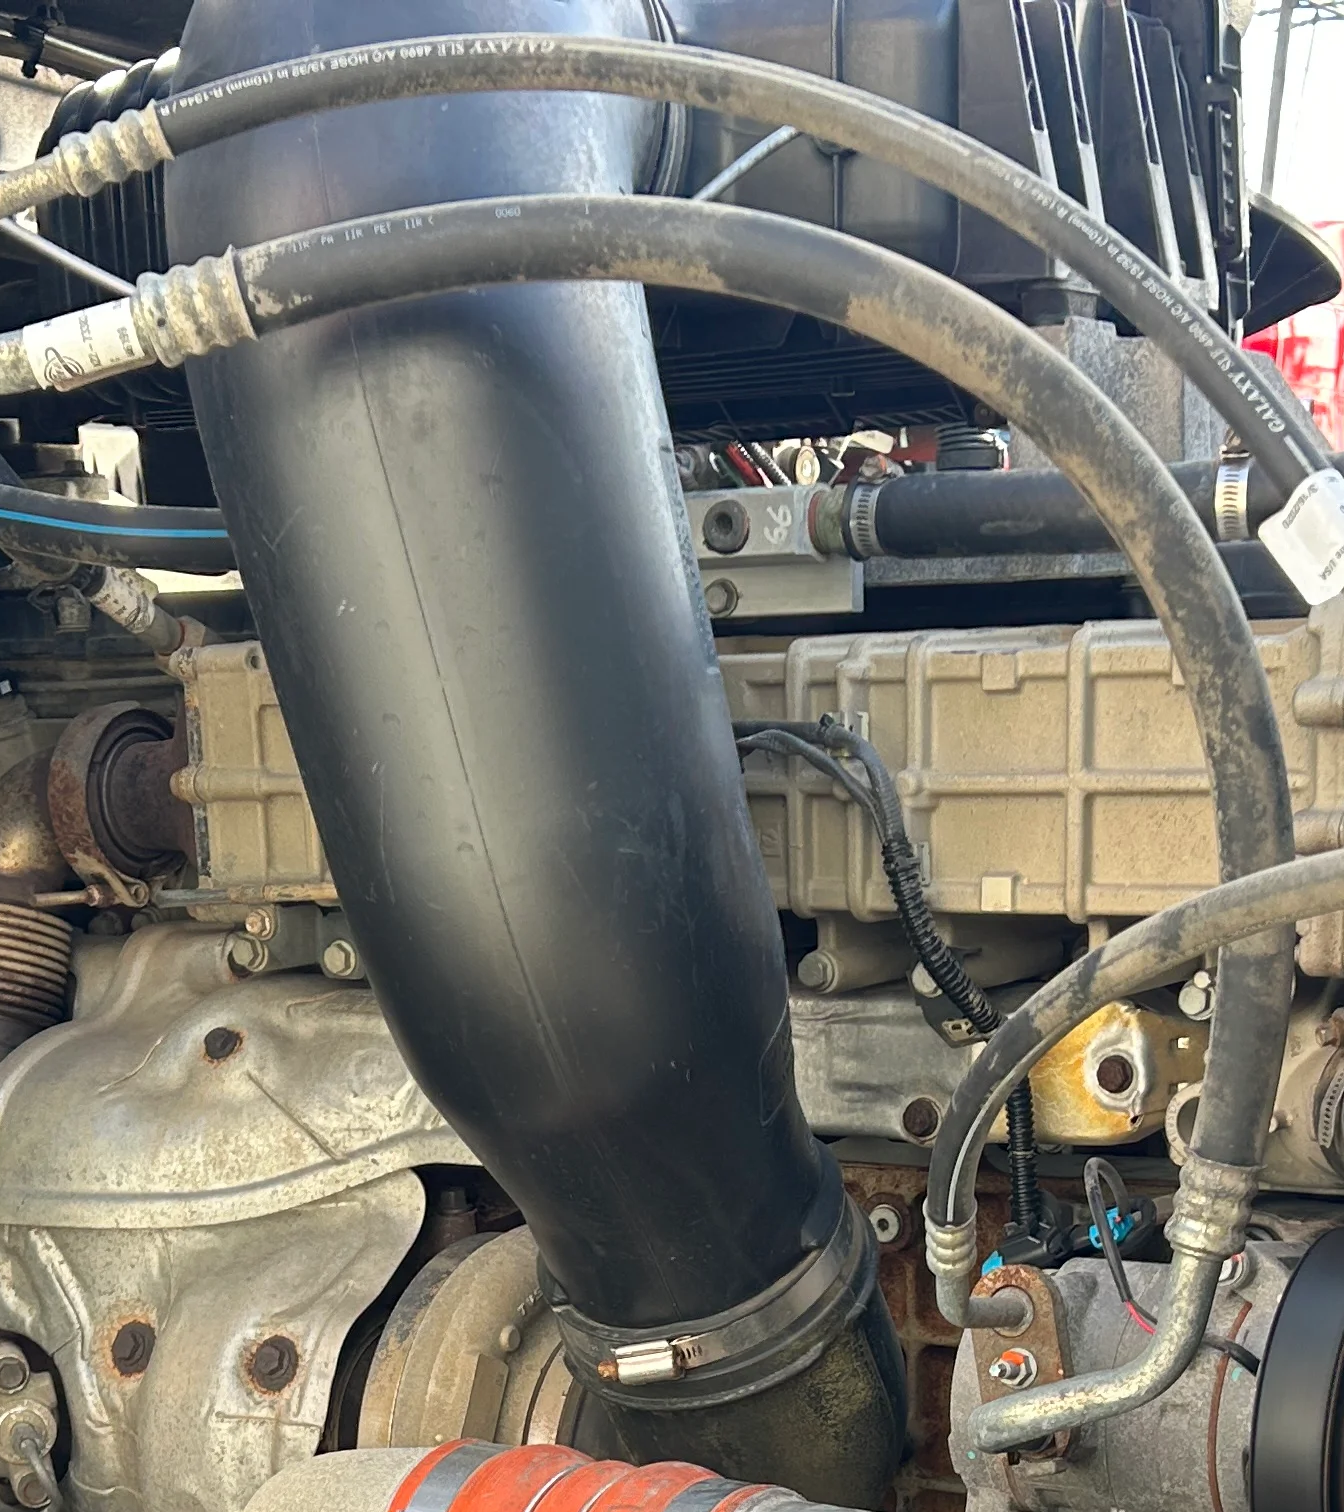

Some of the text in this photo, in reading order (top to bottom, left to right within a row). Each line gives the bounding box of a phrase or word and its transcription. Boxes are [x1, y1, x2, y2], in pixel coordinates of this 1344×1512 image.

[330, 51, 370, 70] HOSE
[1141, 276, 1174, 309] HOSE
[1170, 303, 1193, 325] A/C
[1227, 370, 1286, 434] GALAXY
[1318, 558, 1338, 581] USA
